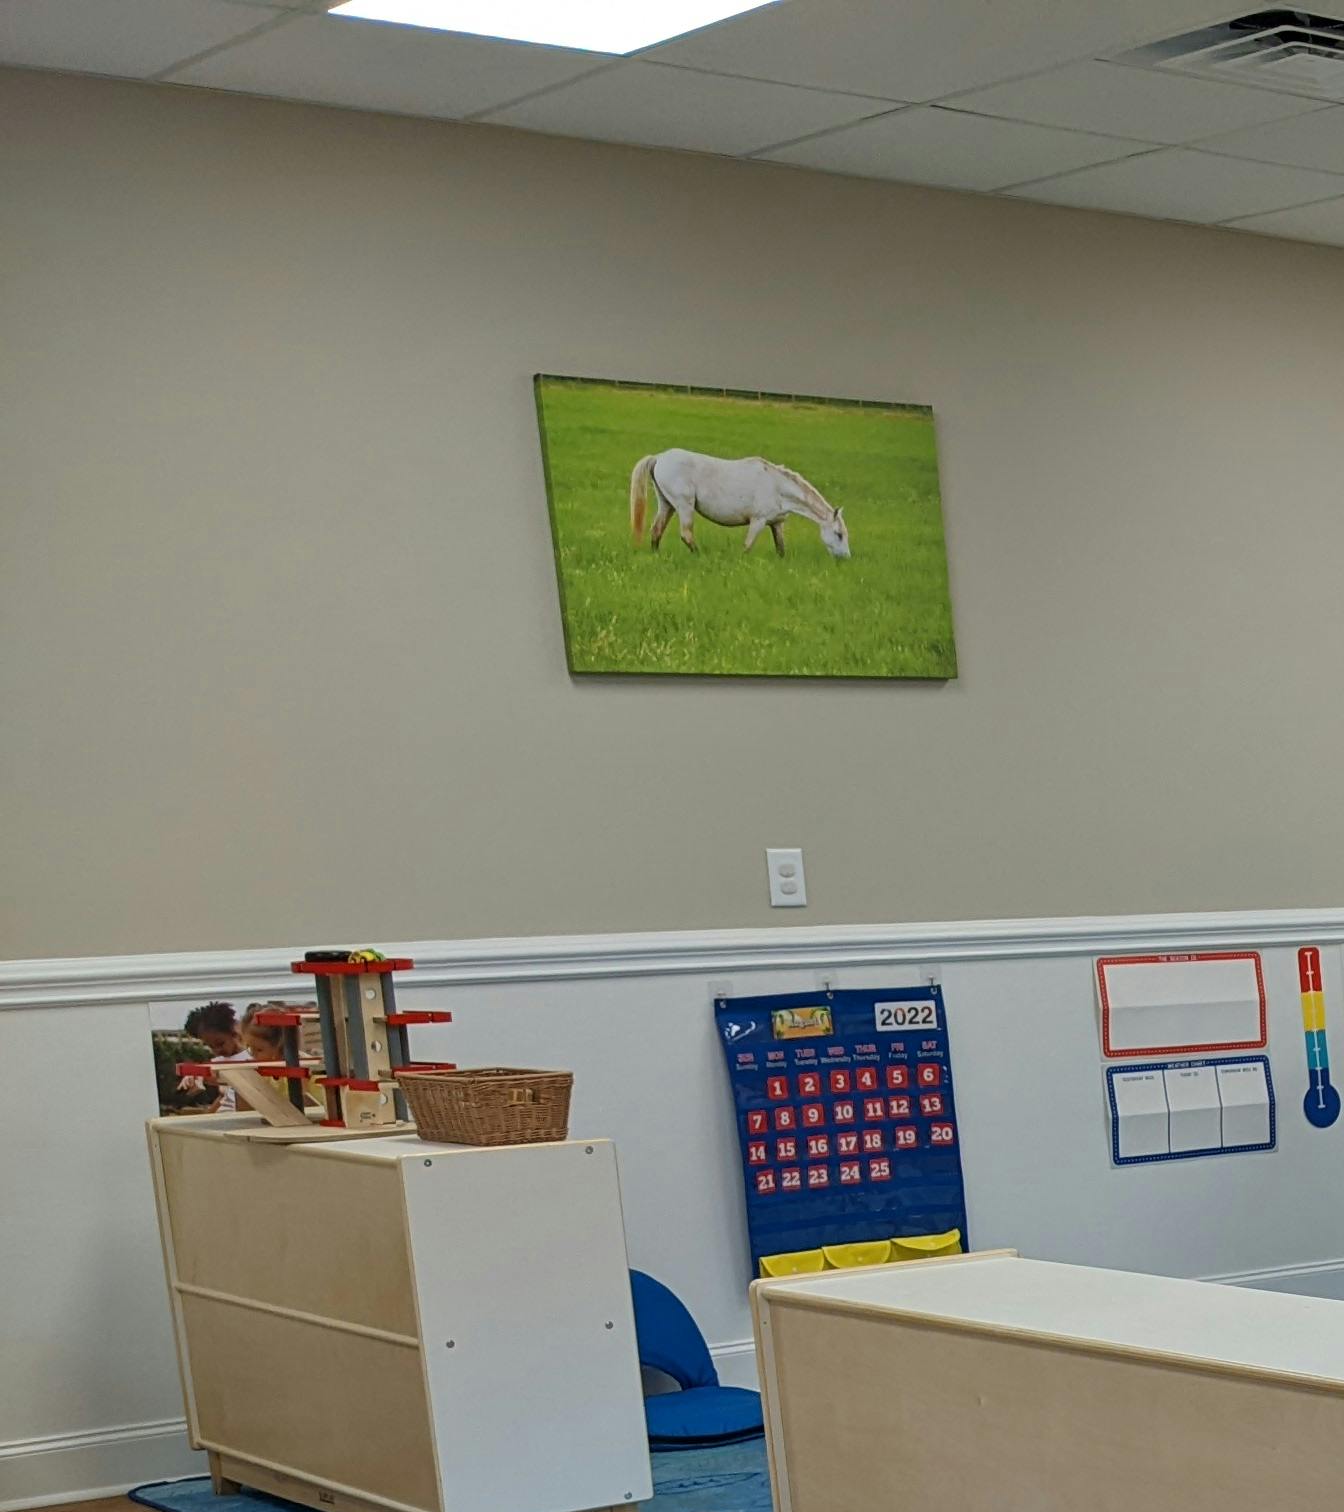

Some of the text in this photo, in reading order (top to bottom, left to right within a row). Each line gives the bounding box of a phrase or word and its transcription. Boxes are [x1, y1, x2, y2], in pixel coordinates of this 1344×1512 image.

[880, 1006, 933, 1026] 2022
[775, 1069, 933, 1094] 1 2 3 4 5 6
[754, 1098, 940, 1128] 7 8 9 10 11 12 13
[751, 1127, 952, 1160] 14 15 16 17 18 19 20
[759, 1163, 889, 1189] 21 22 23 24 25
